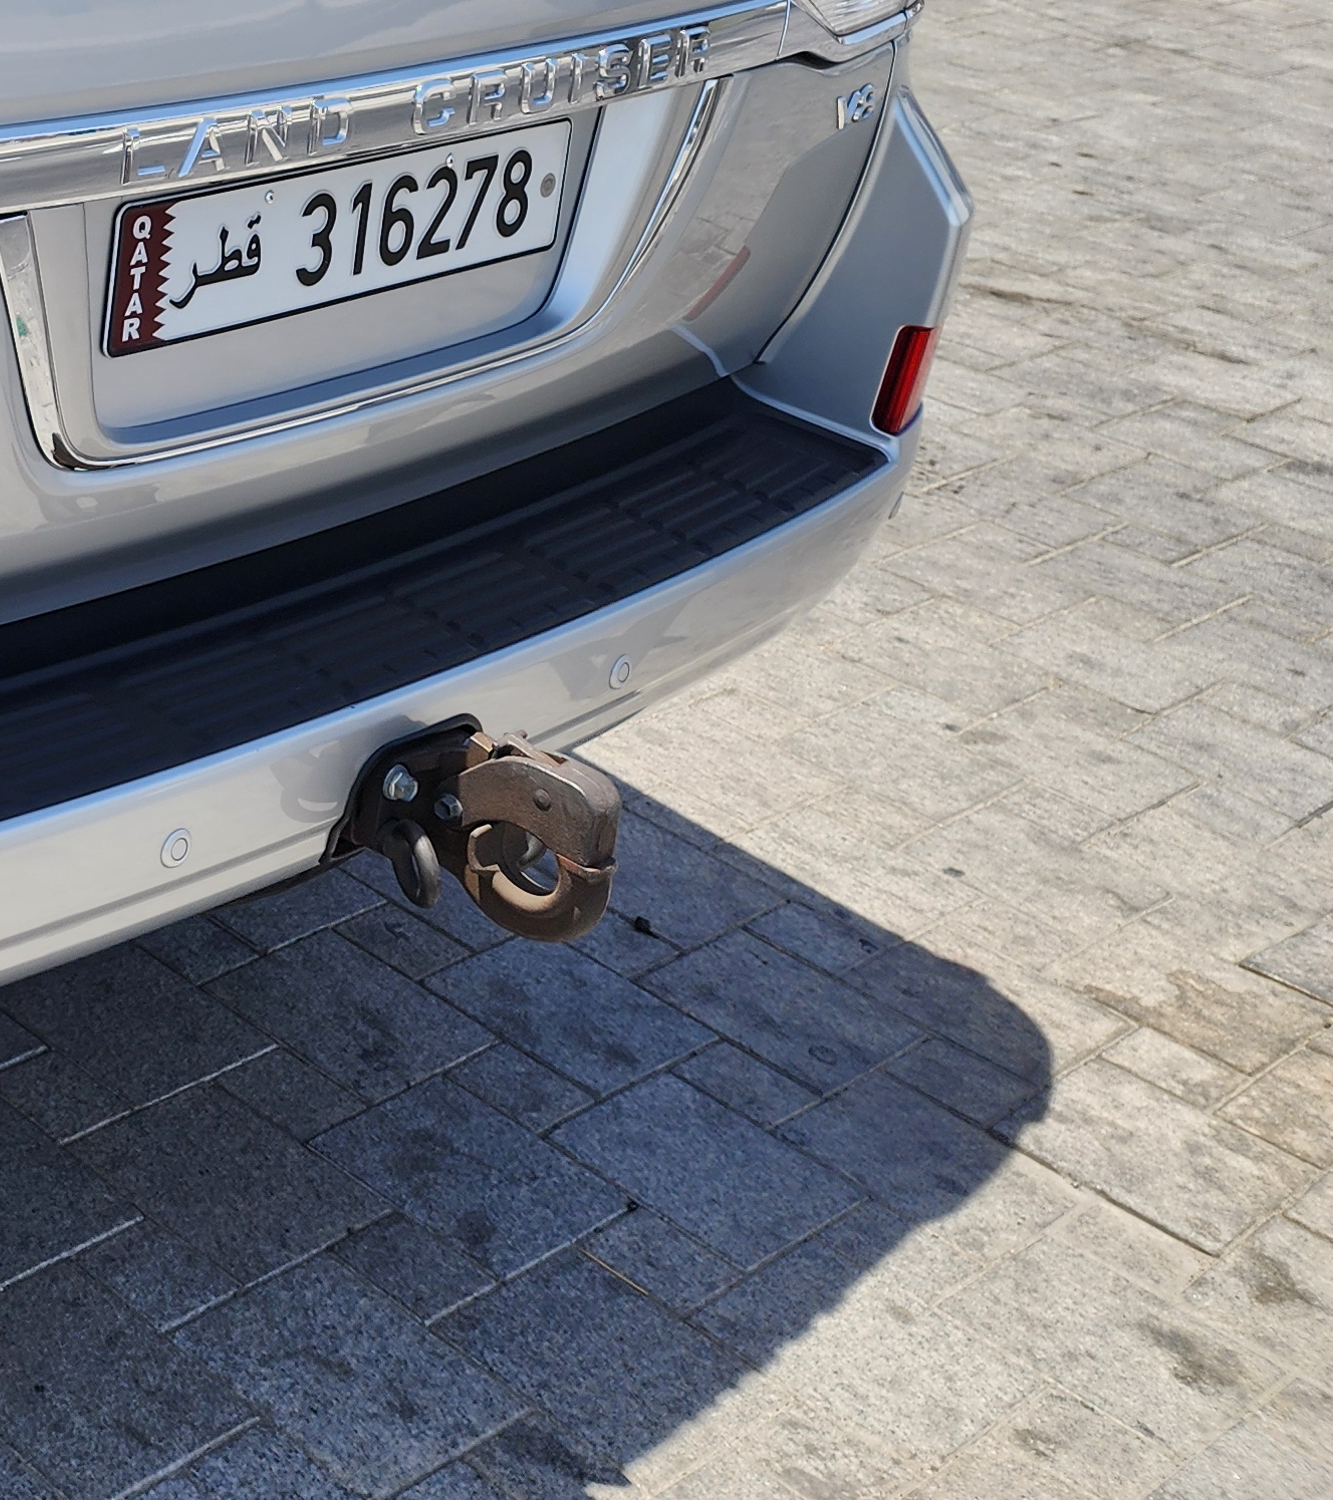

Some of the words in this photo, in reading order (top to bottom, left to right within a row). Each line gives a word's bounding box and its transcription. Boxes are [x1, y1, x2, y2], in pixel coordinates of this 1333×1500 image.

[119, 96, 355, 186] LAND
[411, 25, 714, 136] CRUISER
[121, 215, 152, 342] QATAR
[169, 213, 264, 310] قطر
[295, 149, 534, 287] 316278
